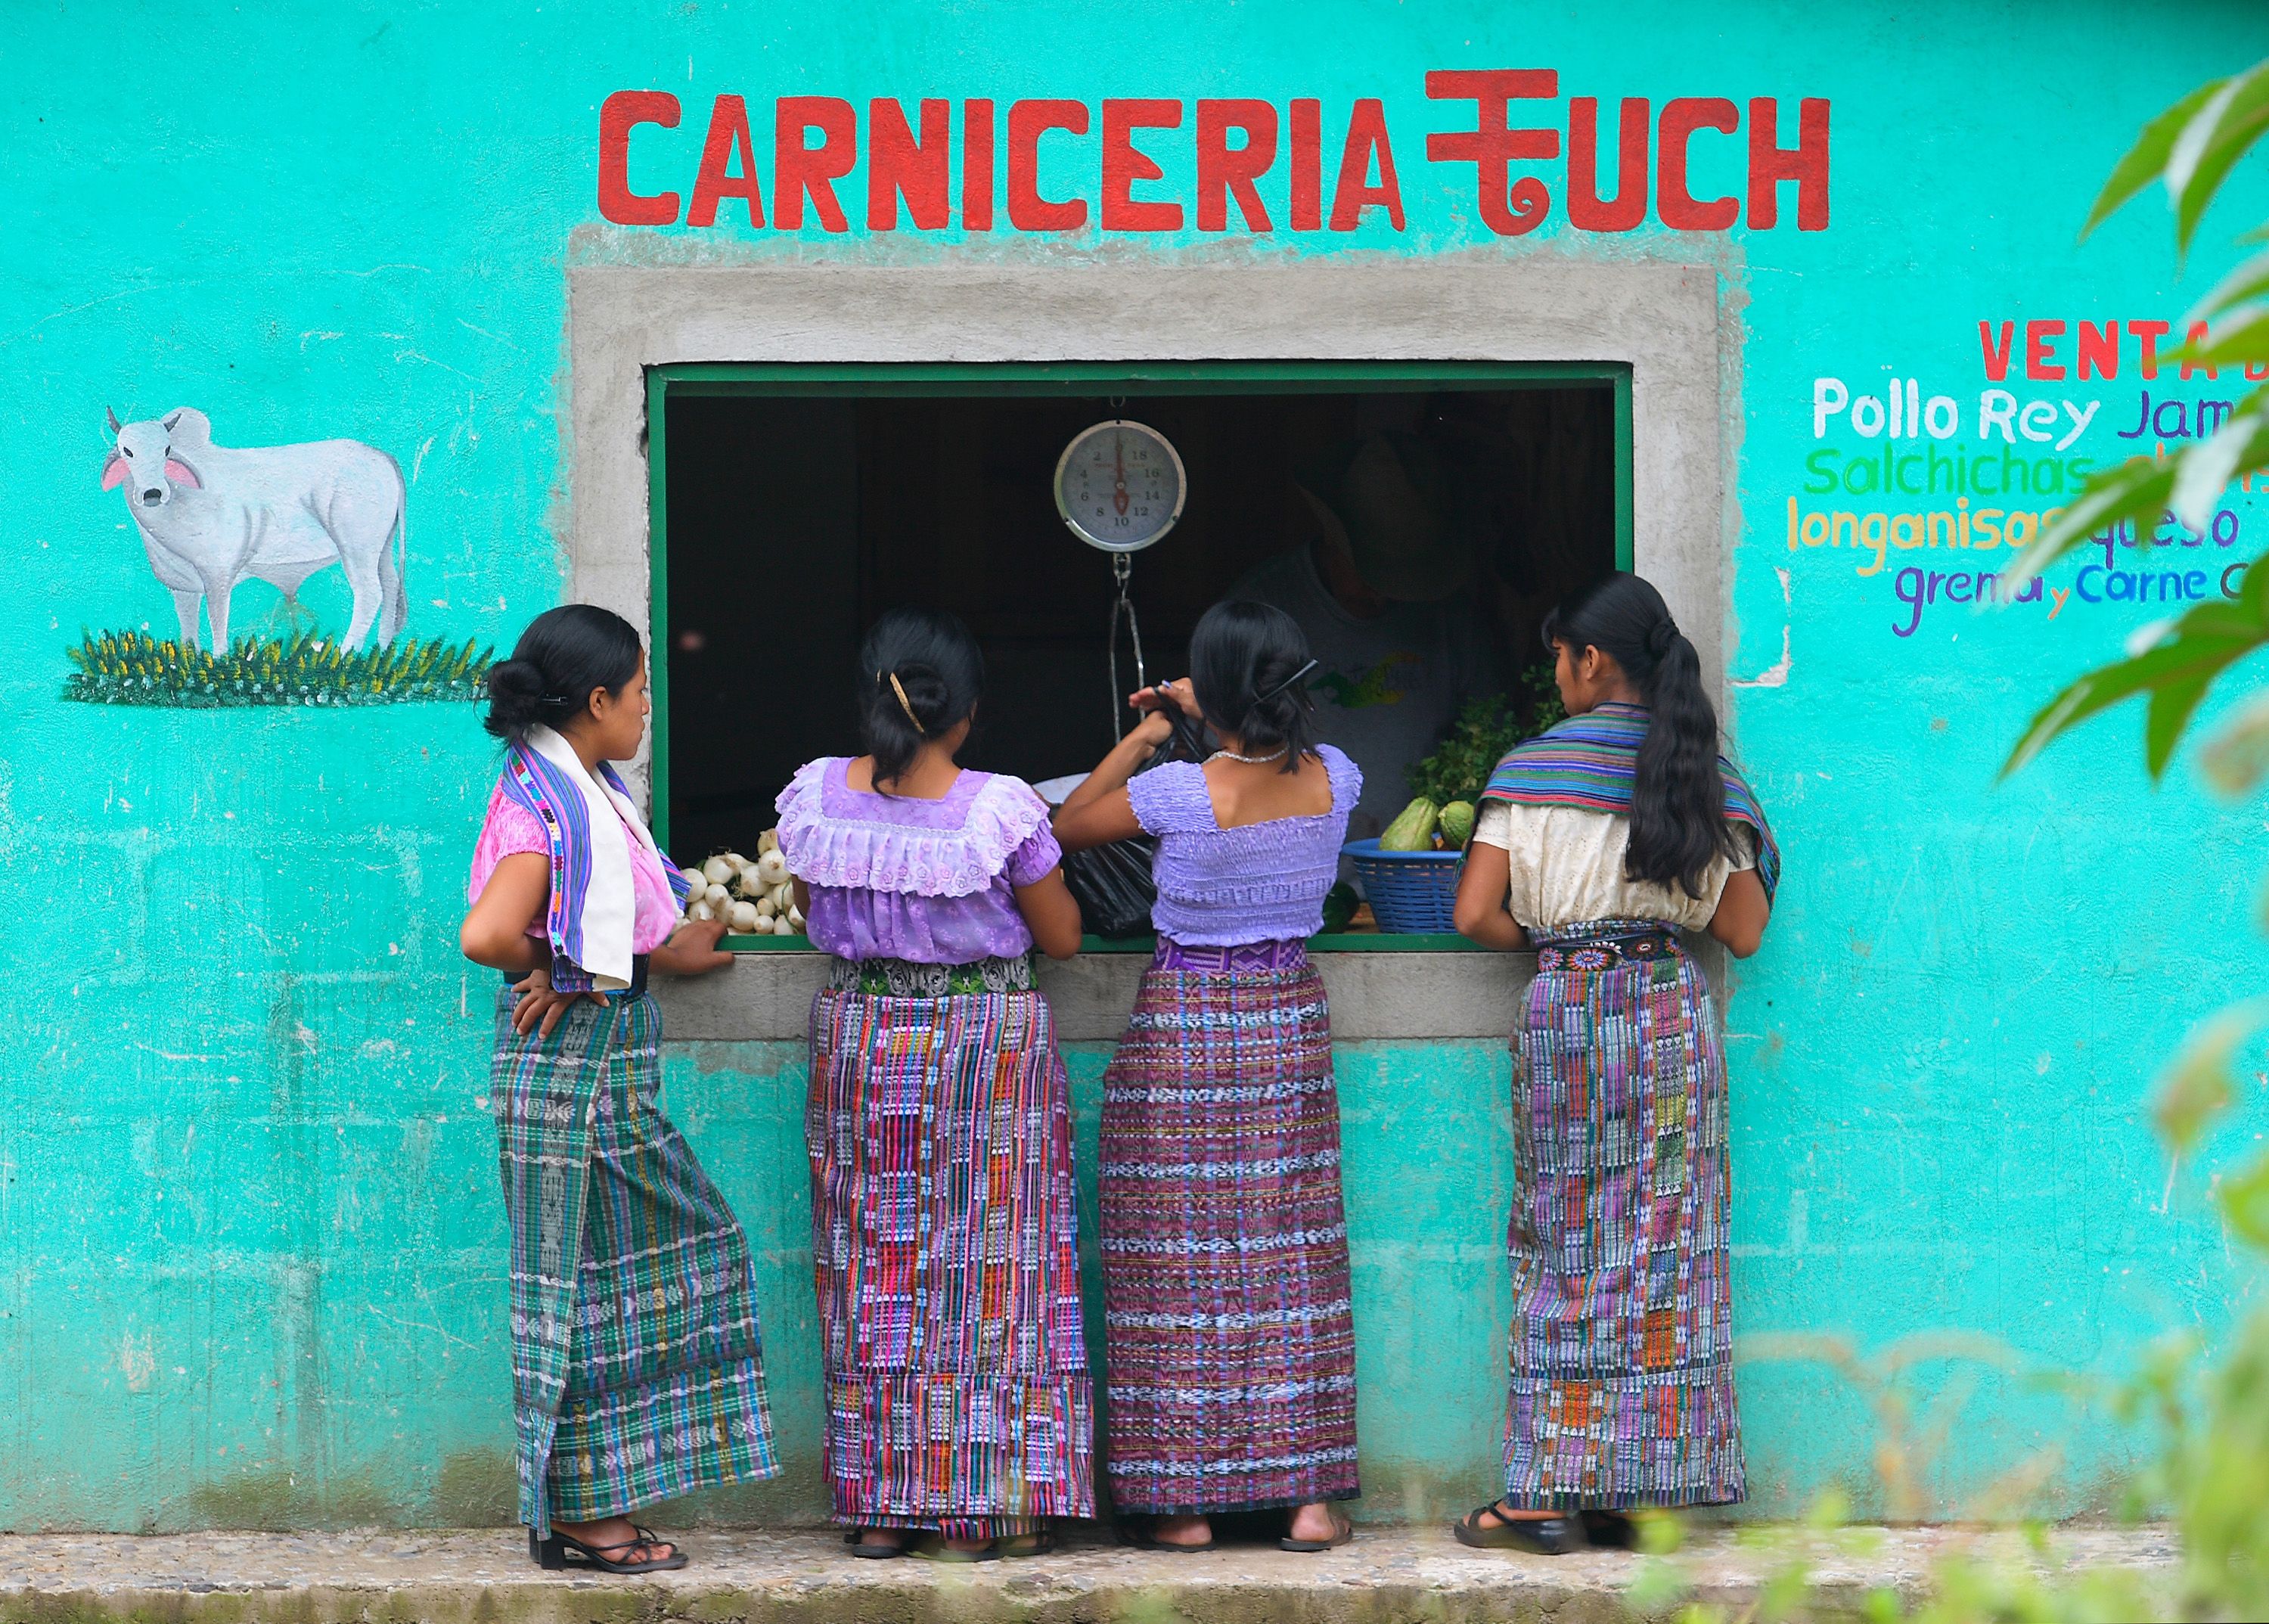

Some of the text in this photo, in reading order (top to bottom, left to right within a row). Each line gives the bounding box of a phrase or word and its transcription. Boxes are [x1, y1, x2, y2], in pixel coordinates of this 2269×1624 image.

[597, 90, 1406, 233] CARNICERIA
[1979, 319, 2218, 380] VENTA
[1814, 378, 1959, 439] Pollo
[1979, 390, 2100, 451] Rey
[1080, 469, 1088, 479] 4
[1144, 468, 1159, 478] 16
[1804, 442, 2095, 497] Salchichas
[1081, 492, 1089, 501] 6
[1145, 491, 1159, 501] 14
[1096, 507, 1104, 517] 8
[1134, 507, 1148, 516] 12
[1114, 517, 1129, 526] 10
[2087, 508, 2240, 570] queso
[2047, 587, 2070, 620] y
[2076, 564, 2208, 603] Carne
